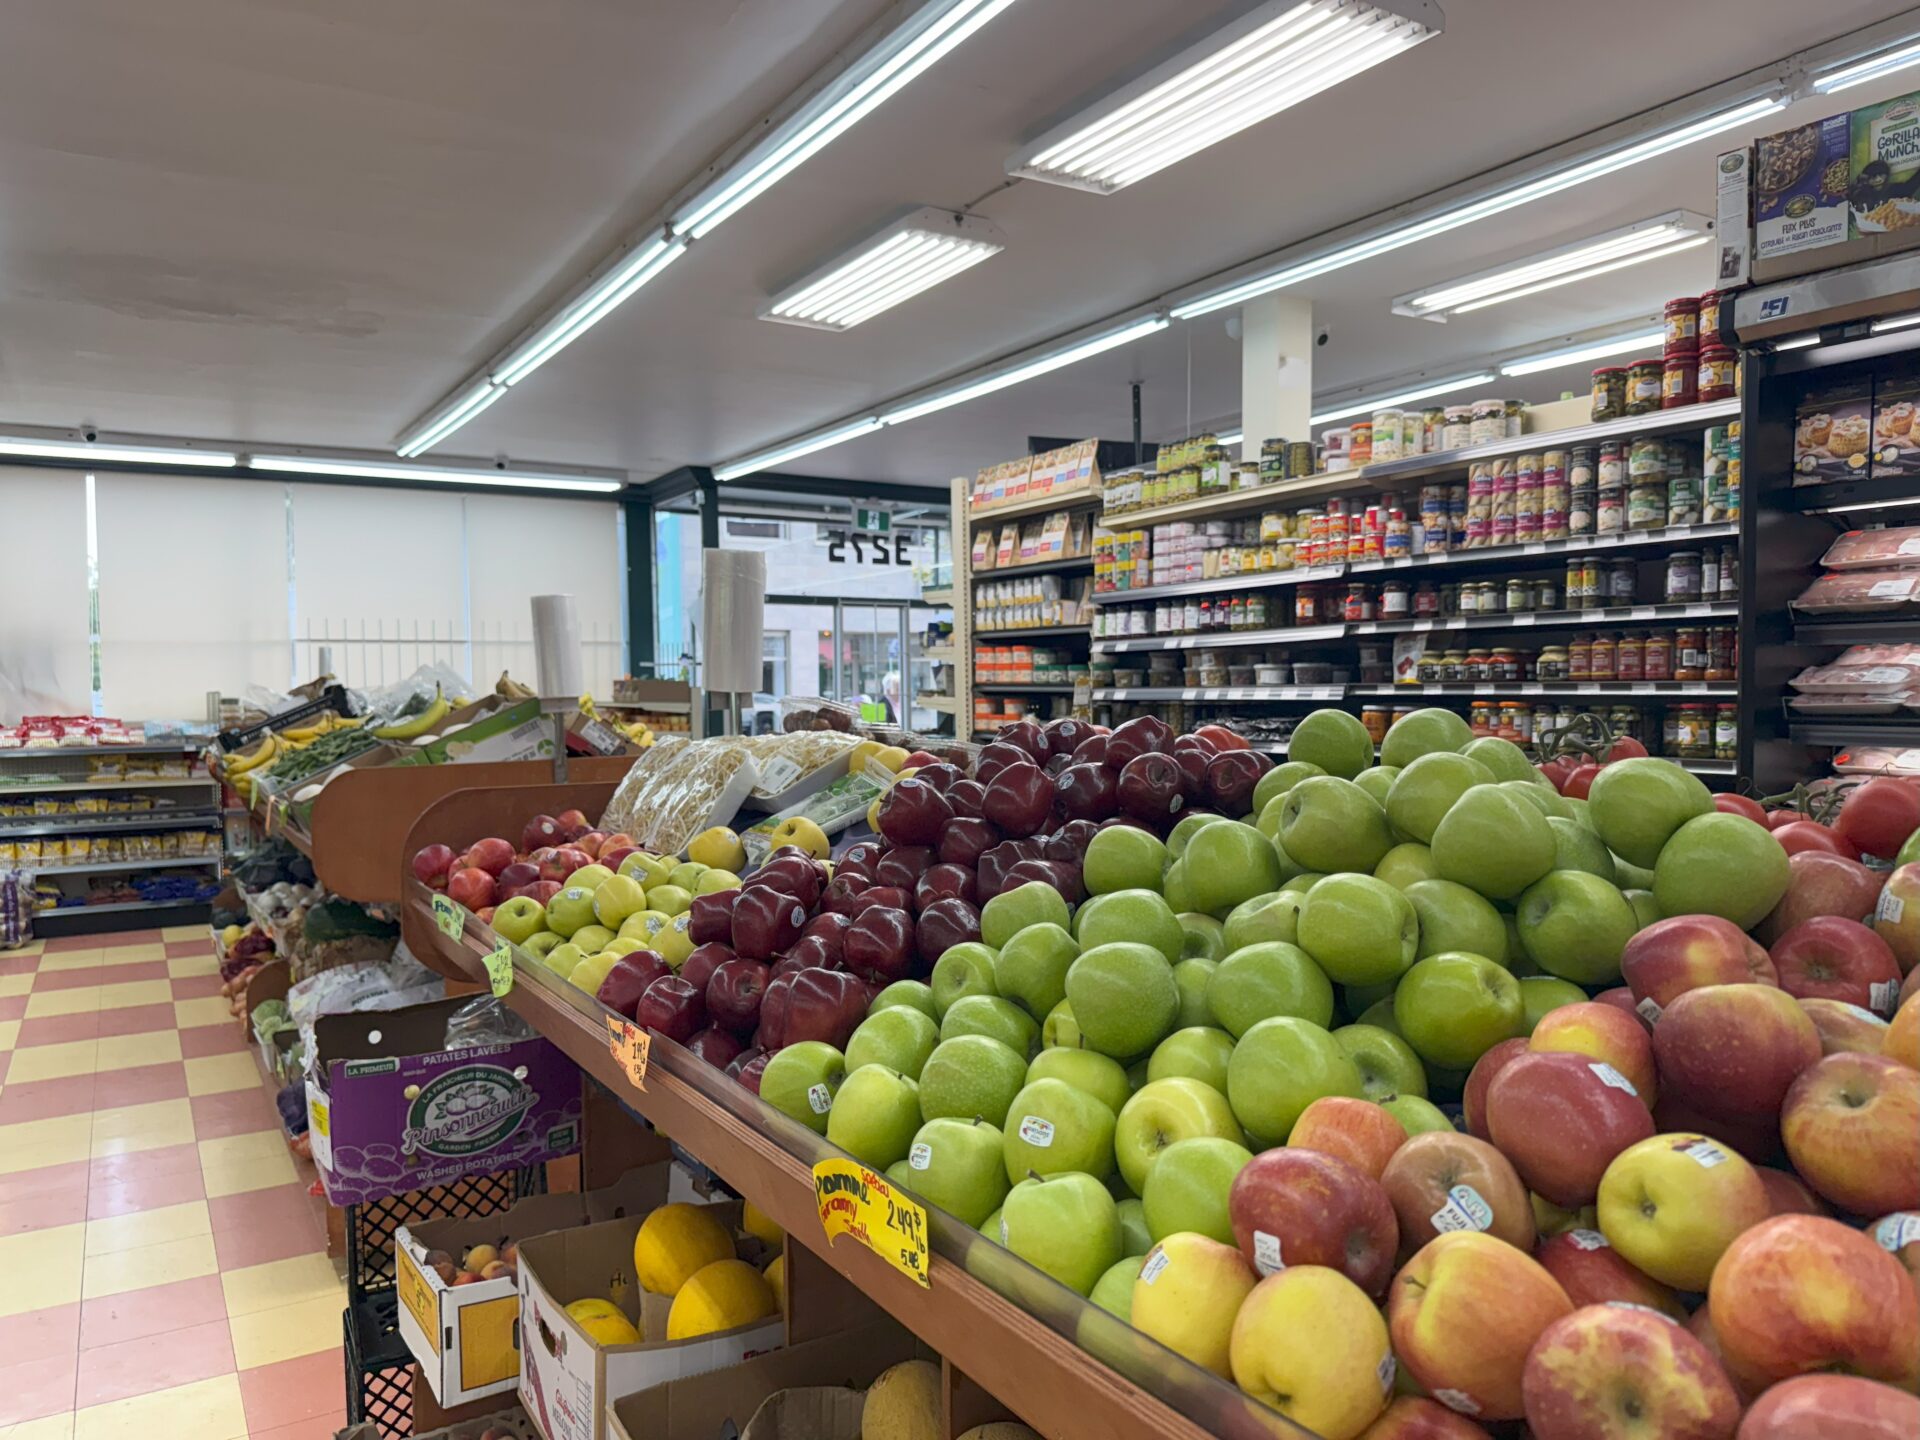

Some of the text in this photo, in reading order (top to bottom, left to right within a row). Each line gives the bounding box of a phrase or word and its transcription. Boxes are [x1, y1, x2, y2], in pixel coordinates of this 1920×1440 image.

[422, 1044, 512, 1066] PATATES LAVÉES
[347, 1063, 395, 1076] LA PRIMEUR
[421, 1091, 434, 1104] LA
[416, 1151, 520, 1181] WASHED POTATOES
[1446, 1207, 1468, 1229] FUJI
